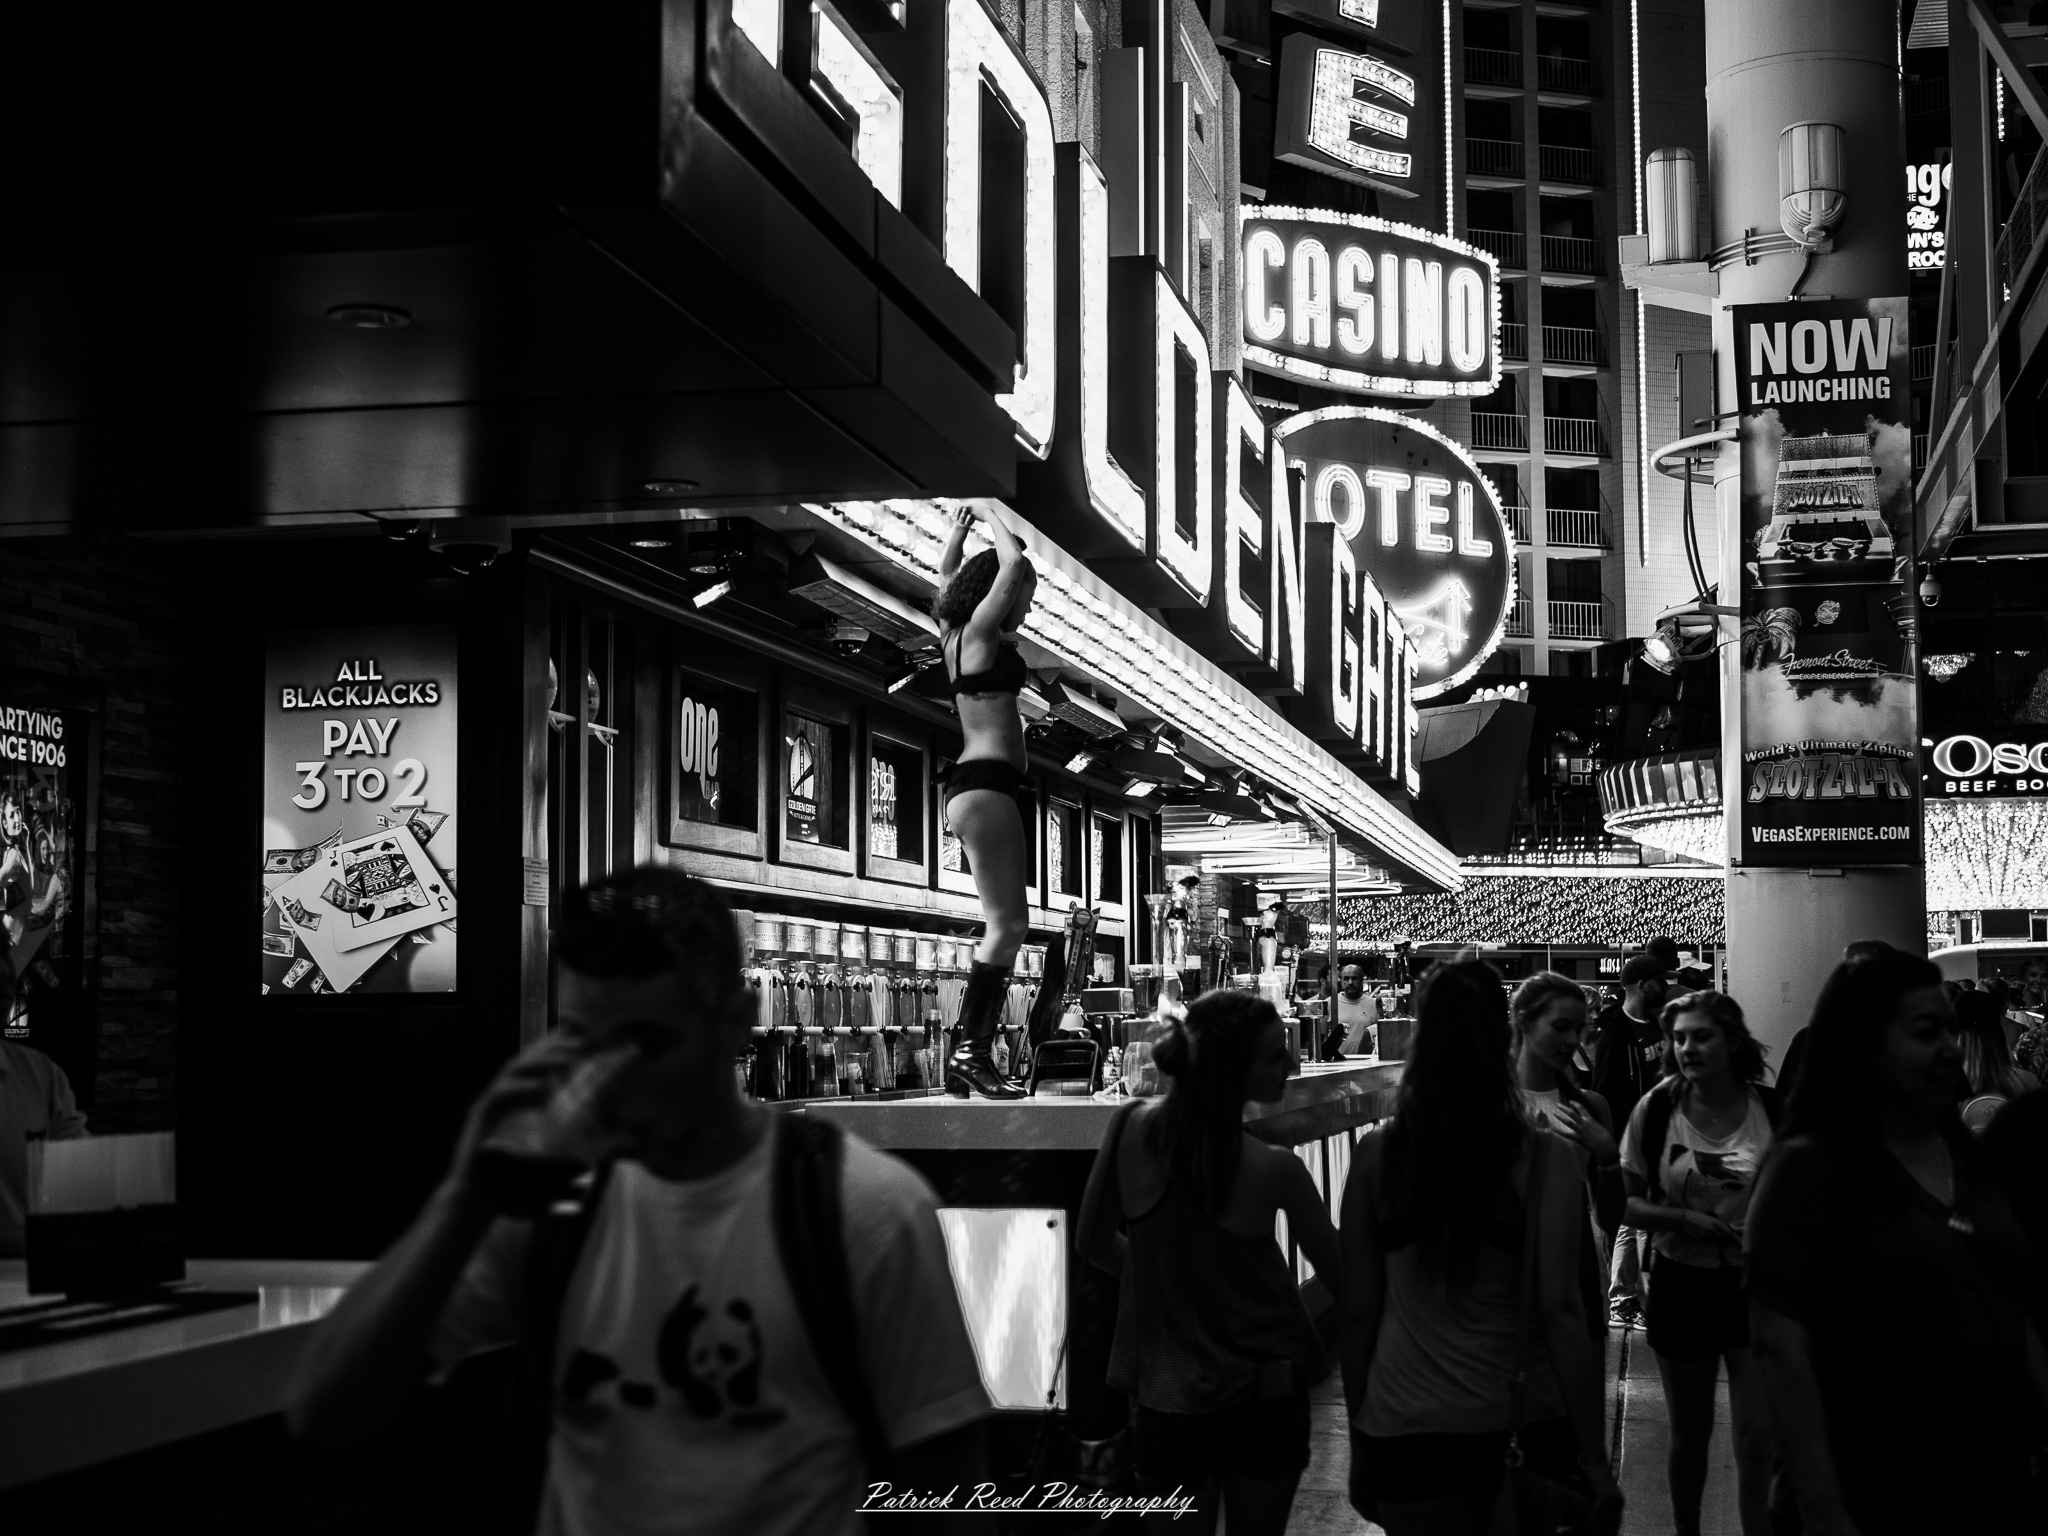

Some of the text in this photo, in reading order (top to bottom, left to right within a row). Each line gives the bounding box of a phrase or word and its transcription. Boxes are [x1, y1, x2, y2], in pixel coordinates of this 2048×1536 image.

[1246, 230, 1485, 373] CASINO
[1750, 317, 1892, 376] NOW
[731, 0, 1419, 799] OLDEN GATE
[1751, 376, 1891, 405] LAUNCHING
[1291, 459, 1493, 558] OTEL
[337, 660, 383, 681] ALL
[1781, 649, 1873, 676] Fremont Street
[1799, 672, 1856, 680] EXPERIENCE
[282, 683, 439, 708] BLACKJACKS
[323, 717, 399, 756] PAY
[1745, 740, 1914, 762] World's Ultimate Zipline
[30, 740, 65, 769] 1906
[291, 758, 427, 809] 3 TO 2
[1748, 753, 1912, 803] SLOTZILLA
[1945, 779, 2048, 793] BEEF BO
[788, 799, 806, 812] GOLDEN
